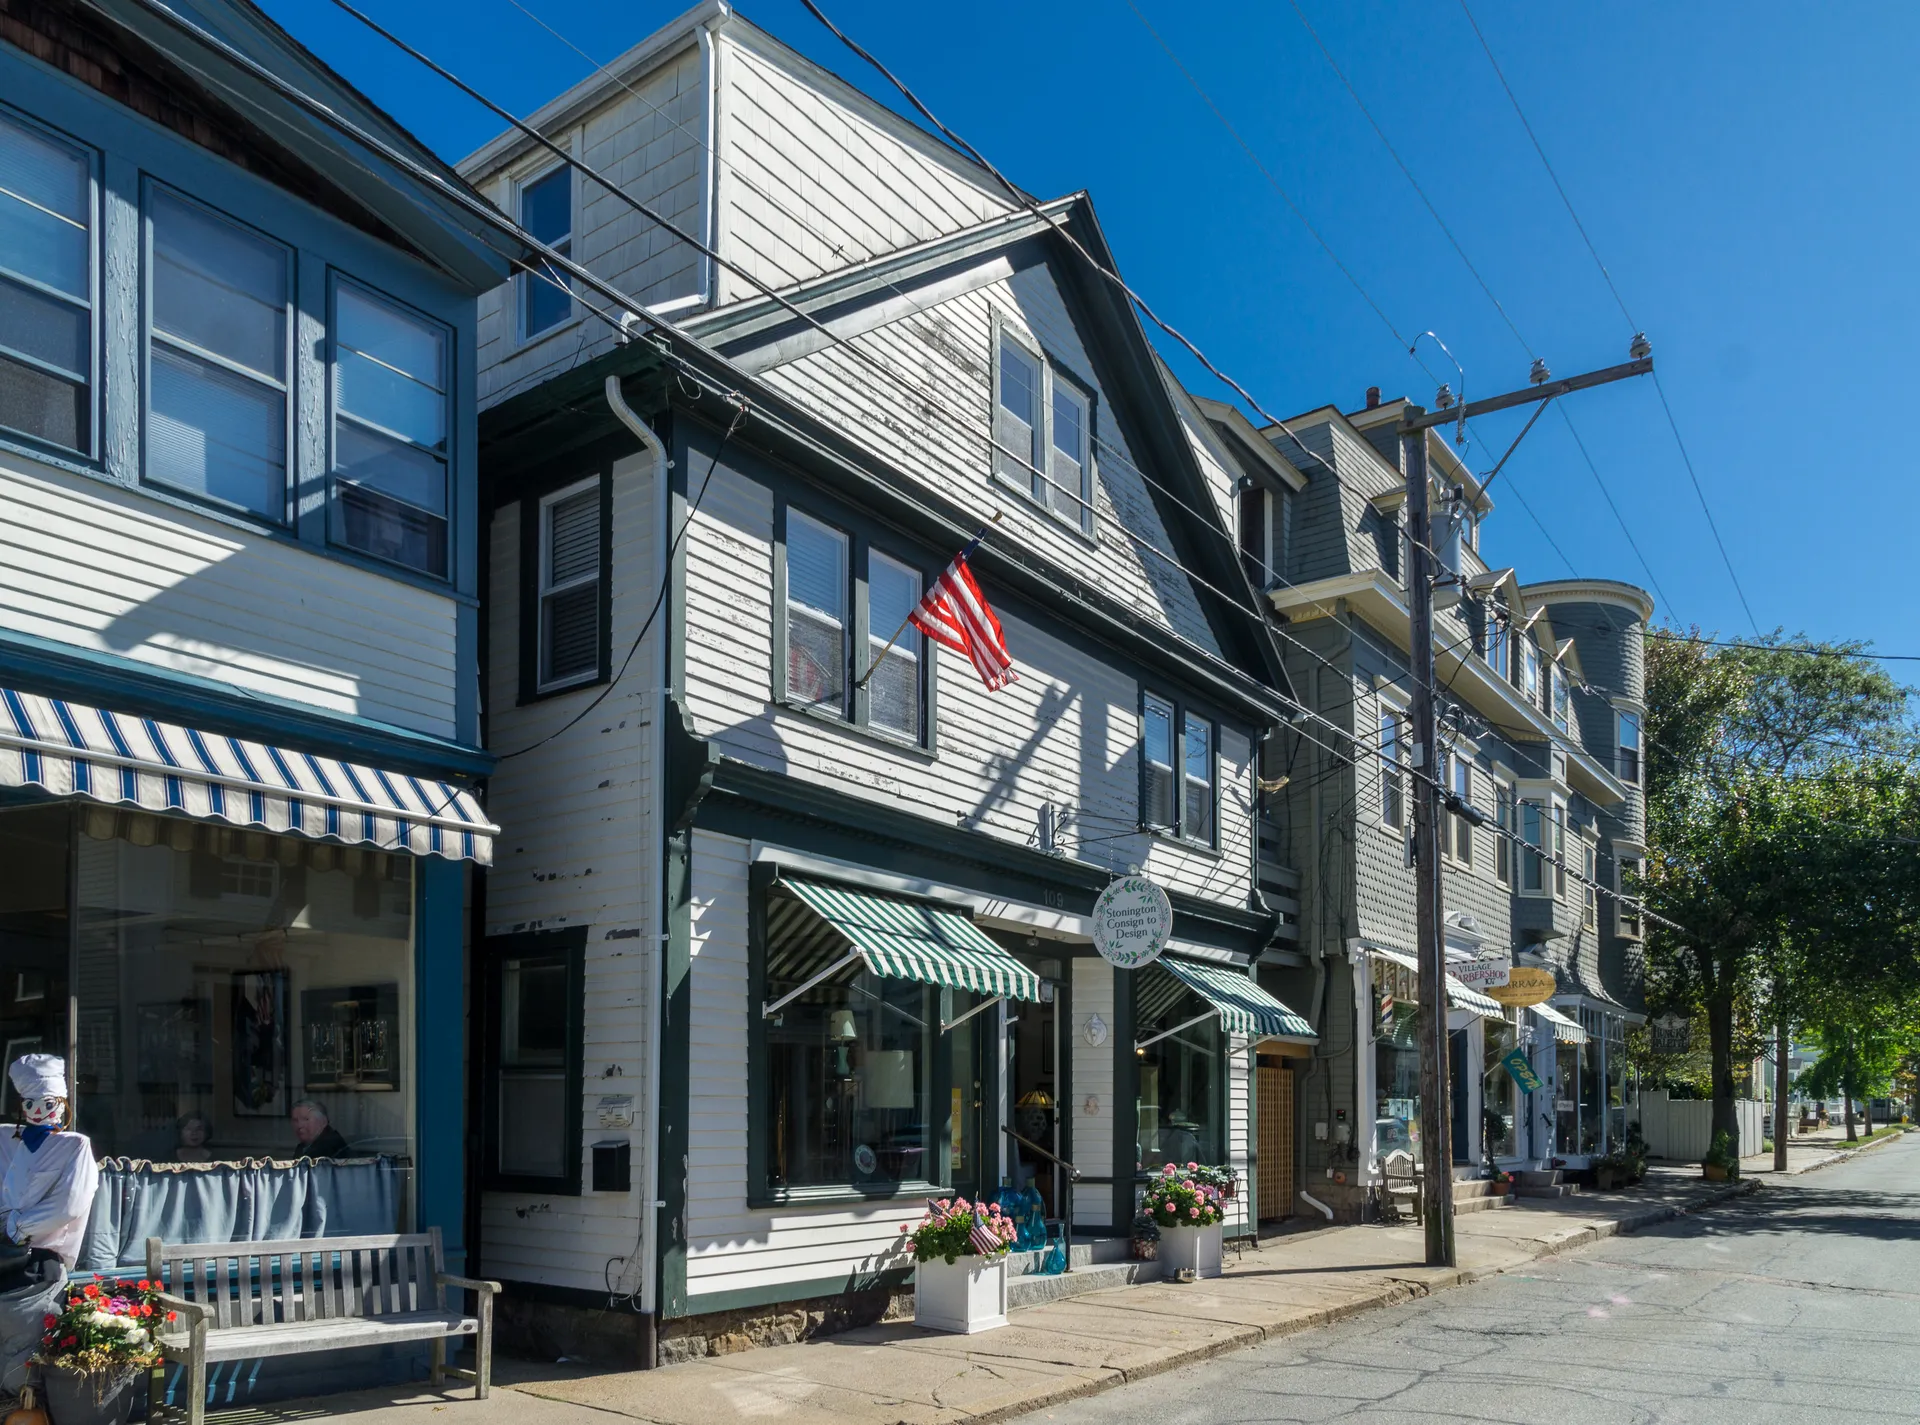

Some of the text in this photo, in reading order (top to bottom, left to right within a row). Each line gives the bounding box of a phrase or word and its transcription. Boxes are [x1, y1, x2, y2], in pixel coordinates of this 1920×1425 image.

[1043, 888, 1064, 908] 109
[1106, 906, 1156, 919] Stonington
[1106, 916, 1157, 930] Consign to
[1115, 928, 1148, 940] Design
[1458, 963, 1492, 973] VILLAGE
[1510, 1058, 1540, 1090] OPEN
